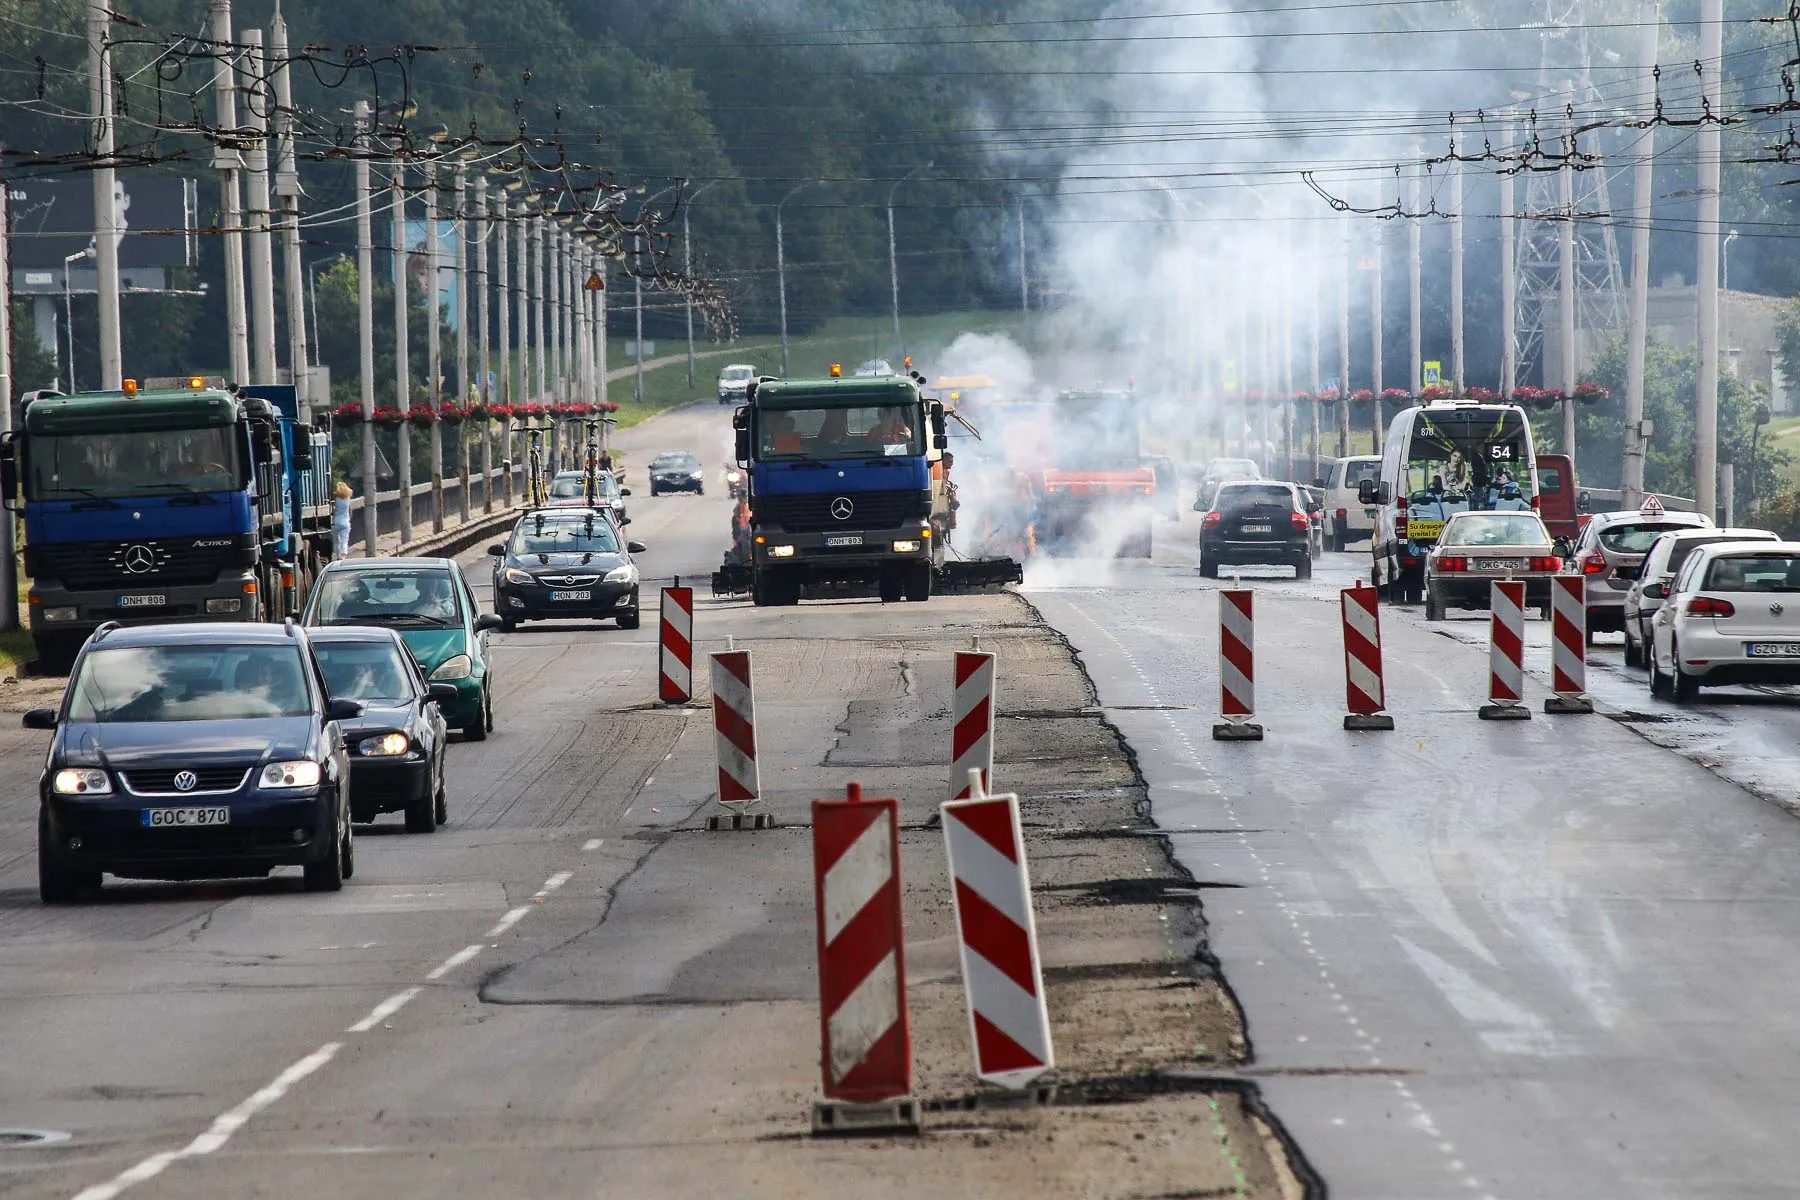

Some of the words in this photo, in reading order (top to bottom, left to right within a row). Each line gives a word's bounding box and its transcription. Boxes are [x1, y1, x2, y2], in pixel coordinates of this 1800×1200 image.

[1420, 427, 1434, 437] 870
[1491, 445, 1511, 459] 54
[123, 597, 142, 606] DNH
[148, 596, 164, 604] 806
[152, 811, 186, 825] GOC
[198, 810, 226, 824] 870
